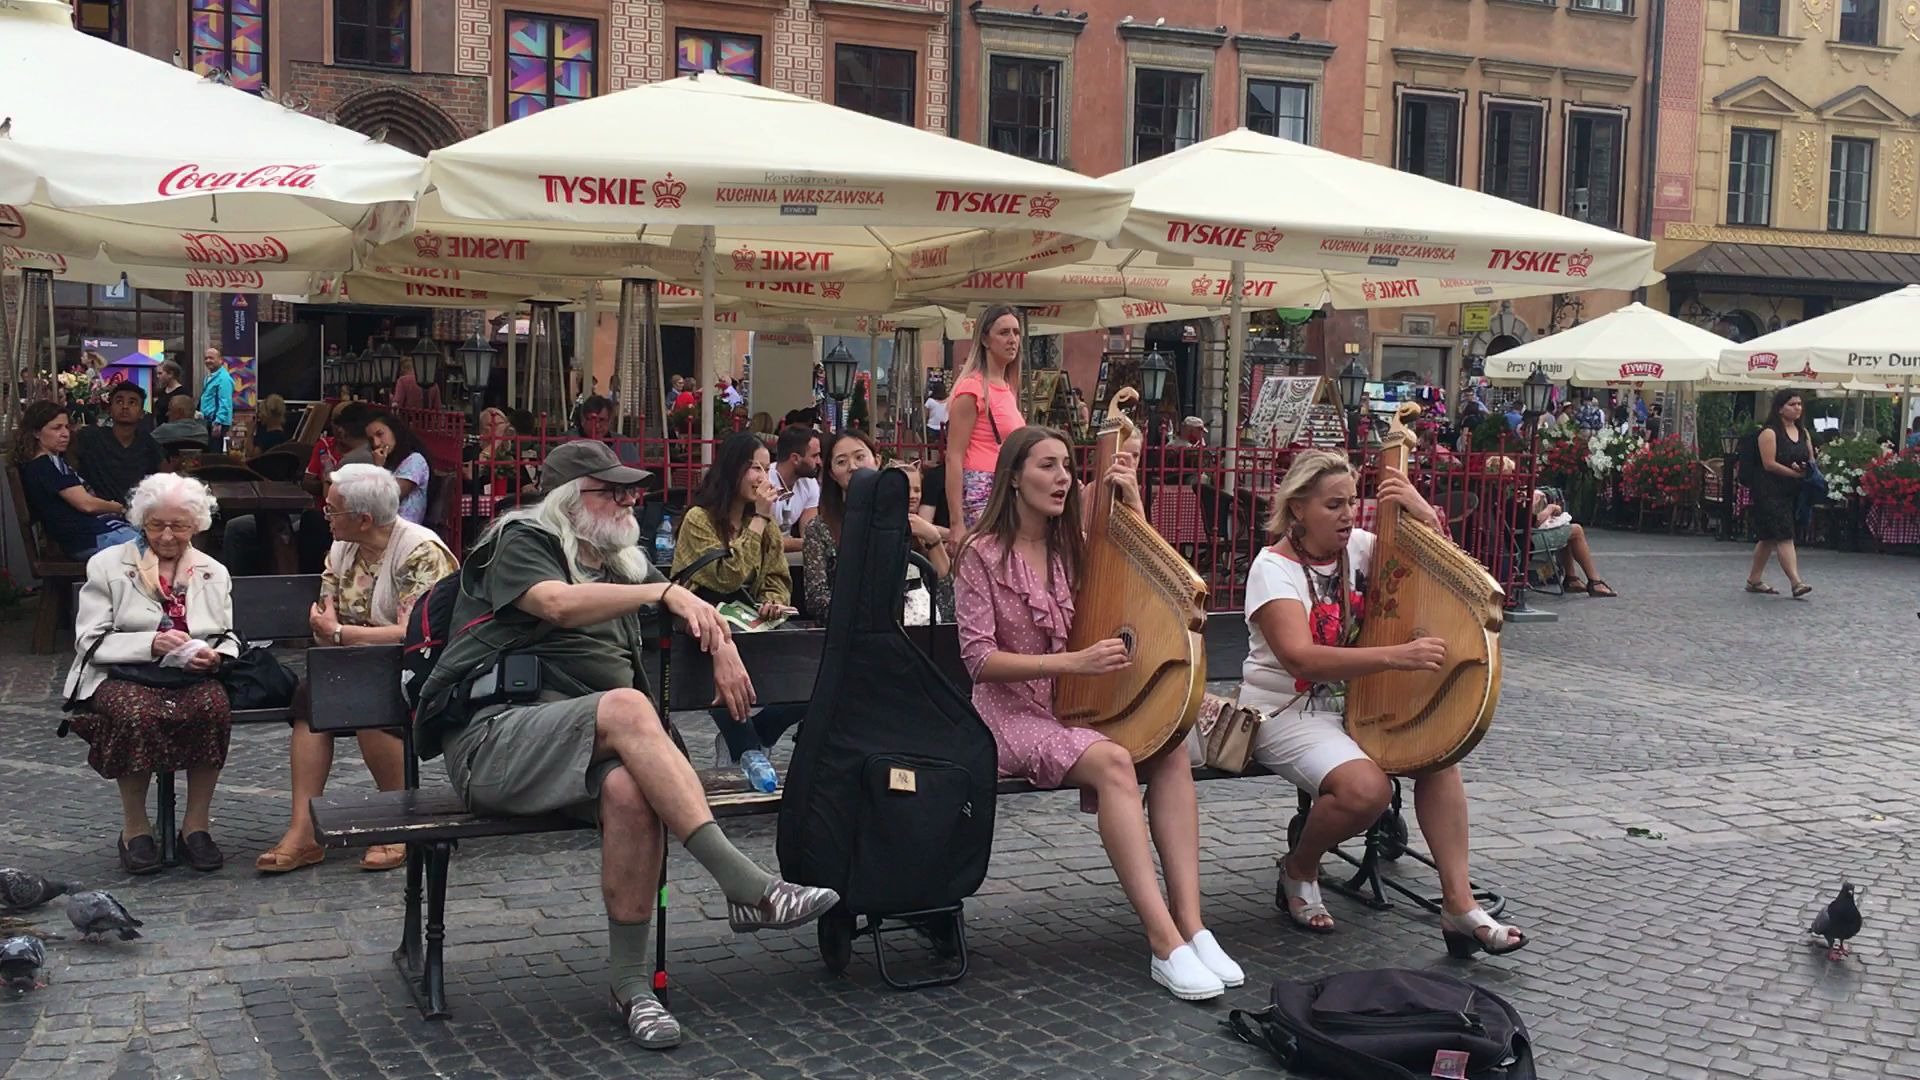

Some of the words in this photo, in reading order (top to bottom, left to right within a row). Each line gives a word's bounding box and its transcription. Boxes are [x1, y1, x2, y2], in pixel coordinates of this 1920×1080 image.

[158, 164, 325, 196] Coca-Cola
[538, 175, 646, 205] TYSKIE
[716, 188, 777, 203] KUCHNIA
[783, 189, 884, 204] WARSZAWSKA
[936, 190, 1027, 214] TYSKIE
[1167, 221, 1253, 248] TYSKIE
[1320, 239, 1370, 254] KUCHNIA
[1373, 243, 1456, 260] WARSZAWSKA
[1488, 249, 1567, 273] TYSKIE
[1529, 361, 1562, 375] Dnaju
[1848, 352, 1882, 369] Przy
